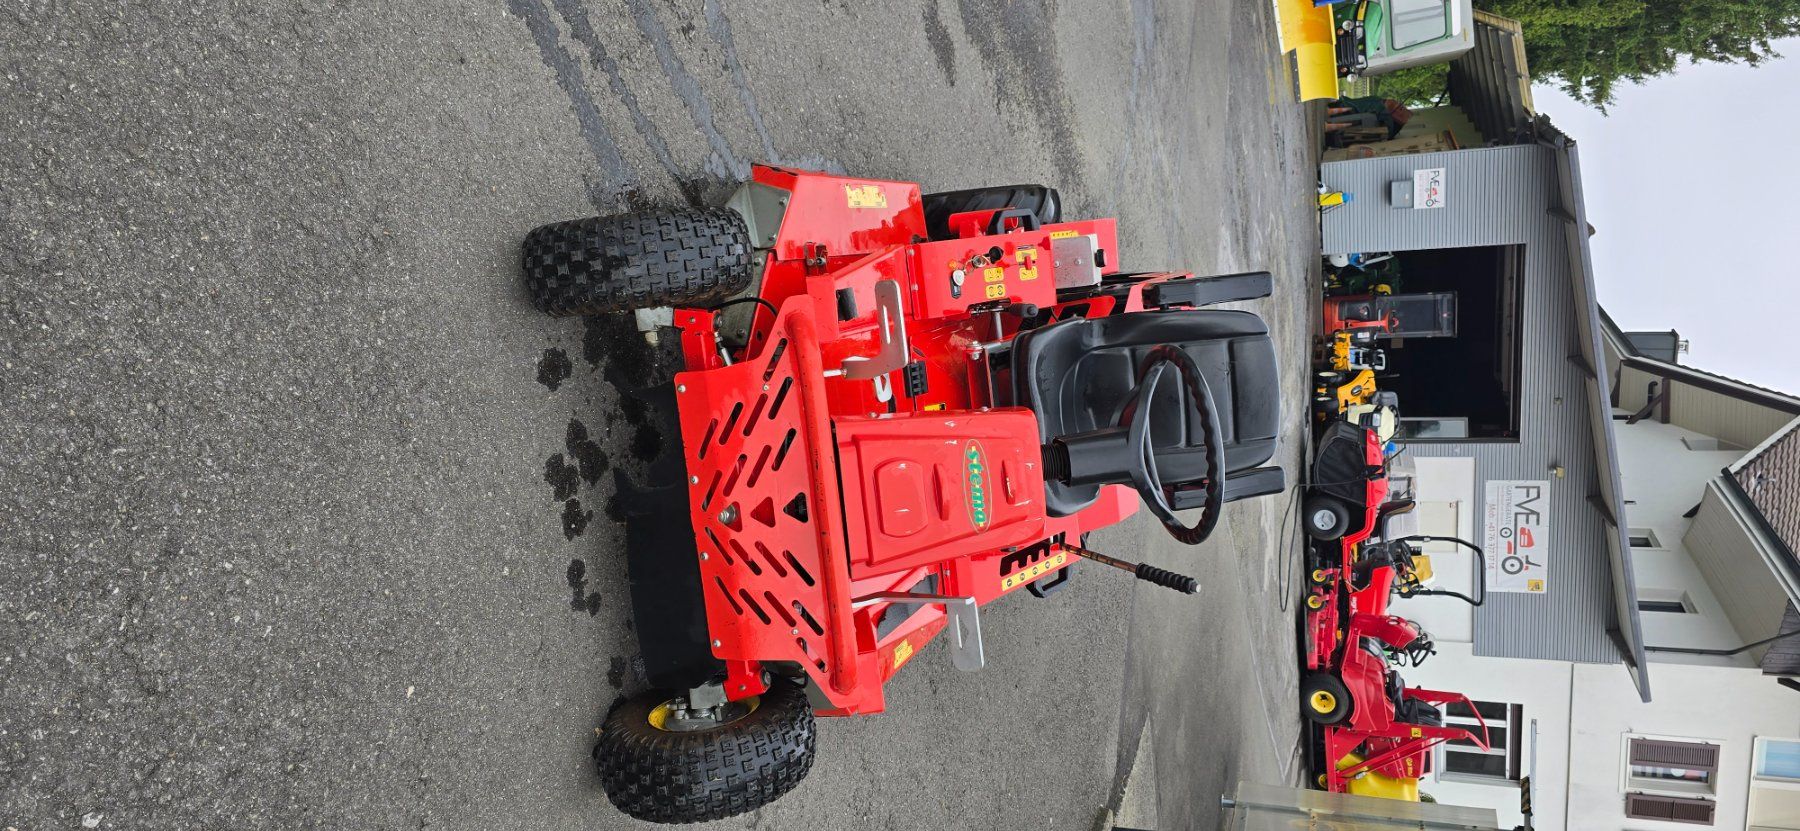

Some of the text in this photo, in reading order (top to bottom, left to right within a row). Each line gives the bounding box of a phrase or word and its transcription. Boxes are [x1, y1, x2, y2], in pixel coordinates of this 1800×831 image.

[966, 449, 987, 525] stema
[1514, 486, 1540, 526] FVE
[1488, 533, 1496, 541] 76
